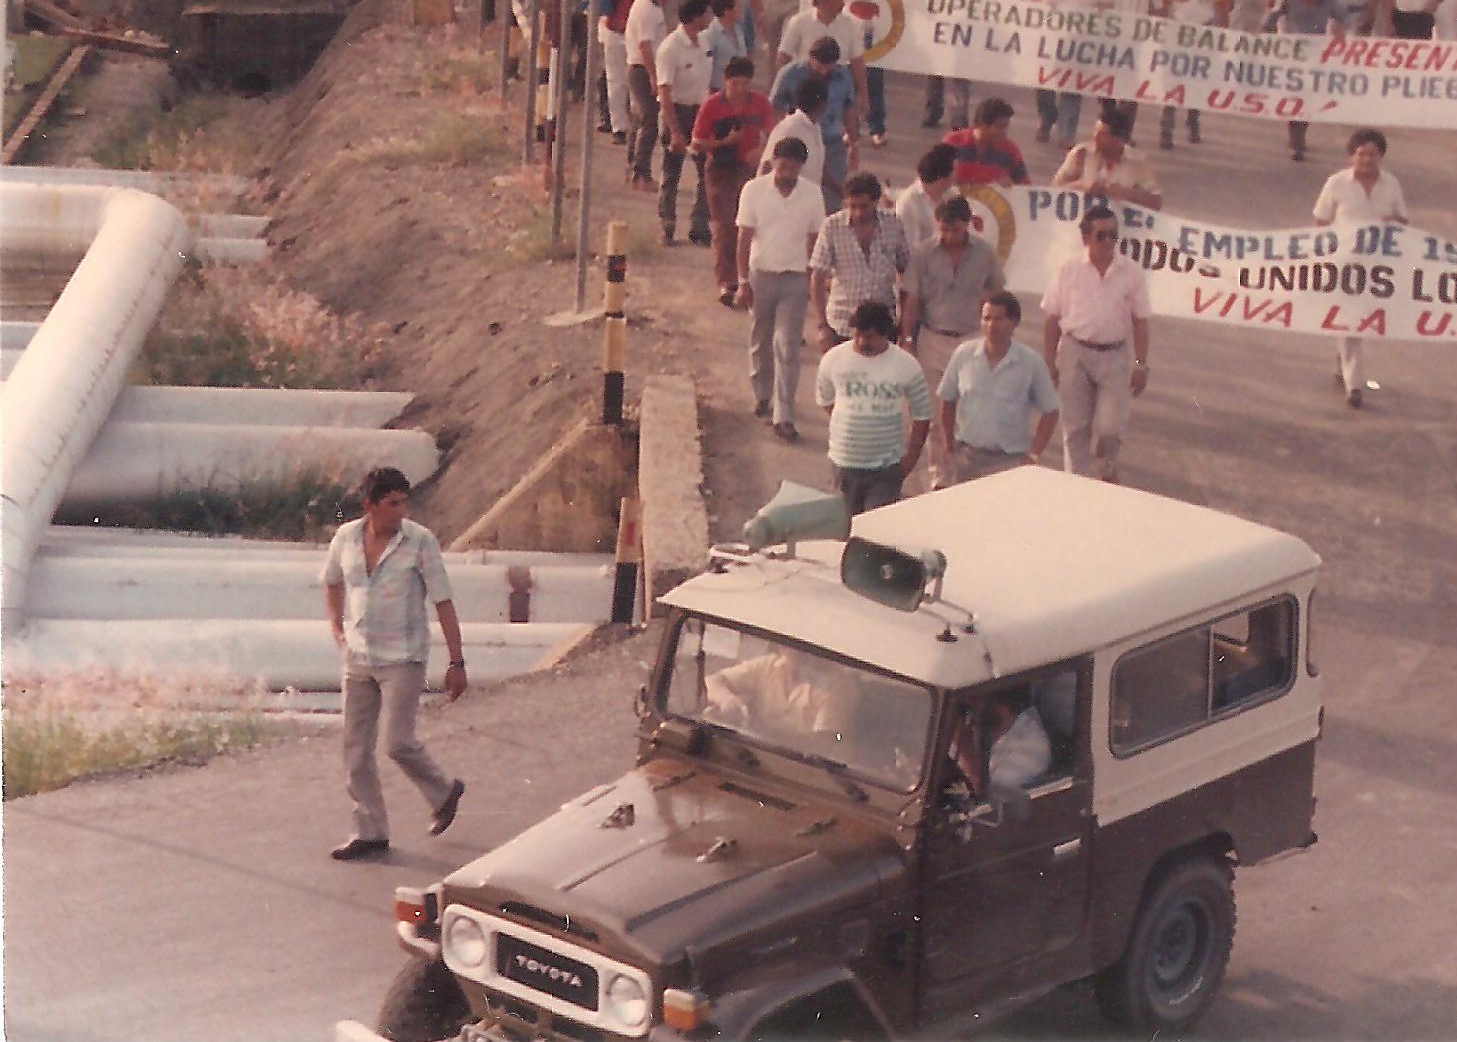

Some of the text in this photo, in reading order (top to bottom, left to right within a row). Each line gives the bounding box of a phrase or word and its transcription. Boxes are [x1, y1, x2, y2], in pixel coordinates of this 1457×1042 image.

[933, 21, 973, 46] EN
[985, 28, 1022, 55] LA
[1038, 35, 1135, 70] LUCHA
[1150, 49, 1211, 79] POR
[1223, 60, 1370, 96] NUESTRO
[1132, 18, 1168, 43] DE
[1177, 24, 1308, 62] BALANCE
[1038, 65, 1116, 97] VIVA
[1136, 79, 1186, 106] LA
[1178, 224, 1338, 261] EMPLEO
[1350, 223, 1406, 257] DE
[1239, 261, 1396, 300] UNIDOS
[1194, 286, 1294, 329] VIVA
[1321, 304, 1387, 337] LA
[515, 954, 583, 988] TOYOTA
